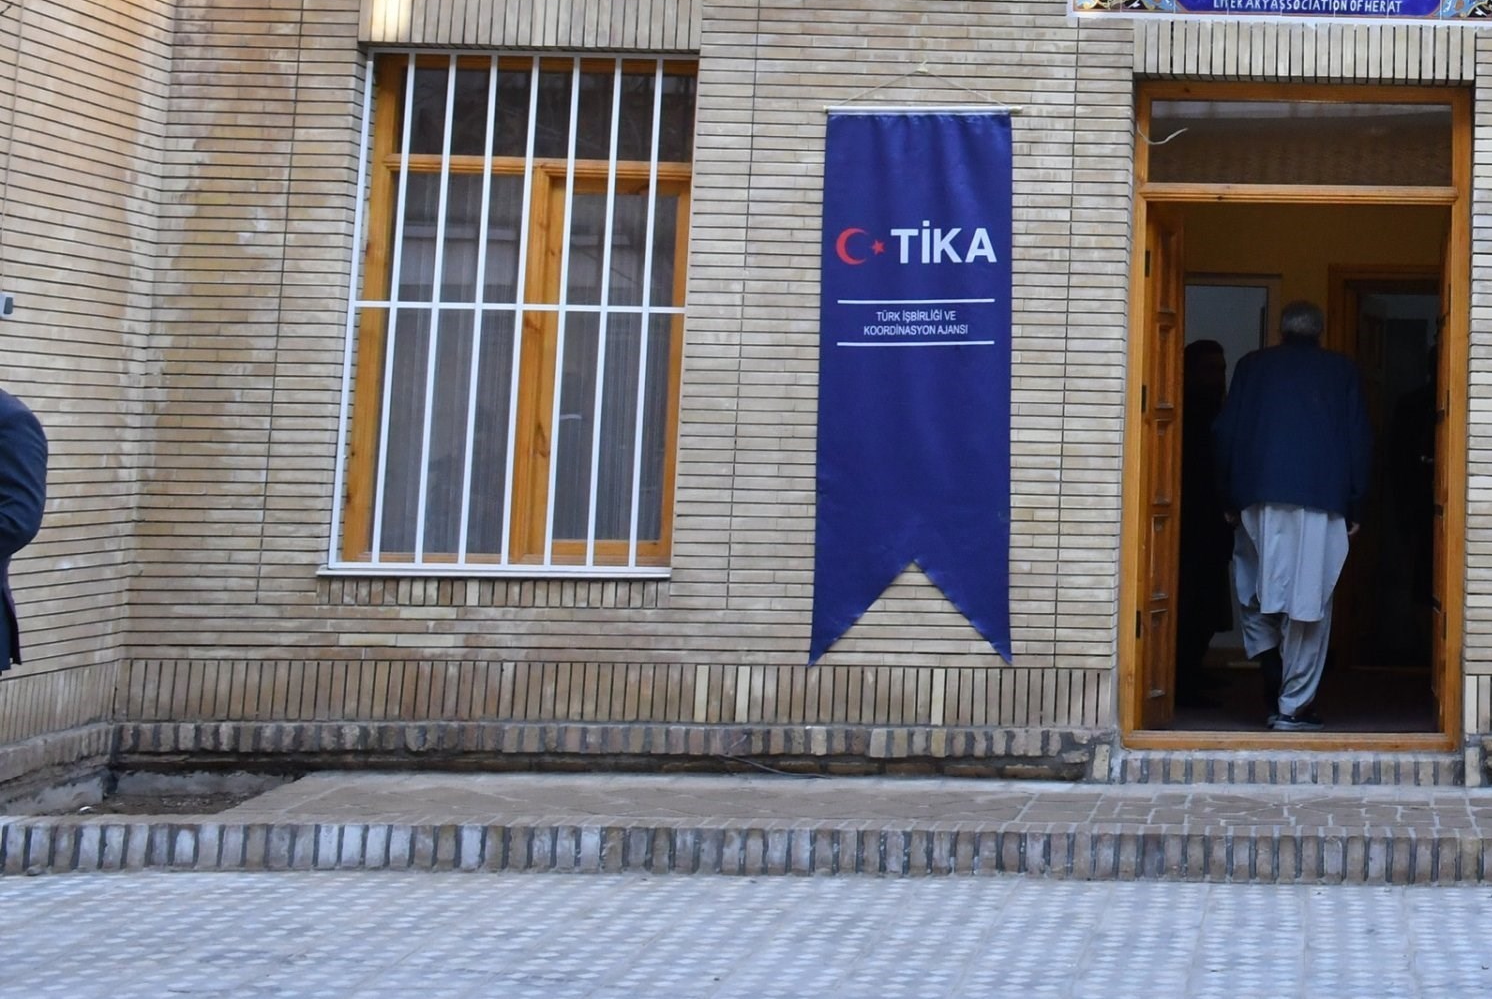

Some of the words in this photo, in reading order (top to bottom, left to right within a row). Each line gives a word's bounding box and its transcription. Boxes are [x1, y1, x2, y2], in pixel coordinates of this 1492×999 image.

[1364, 0, 1402, 13] HERAT
[890, 220, 998, 264] TİKA
[876, 310, 900, 322] TÜRK
[902, 309, 942, 323] İŞBİRLİĞİ
[944, 310, 956, 321] VE
[863, 324, 936, 336] KOORDİNASYON
[937, 324, 968, 335] AJANSI
